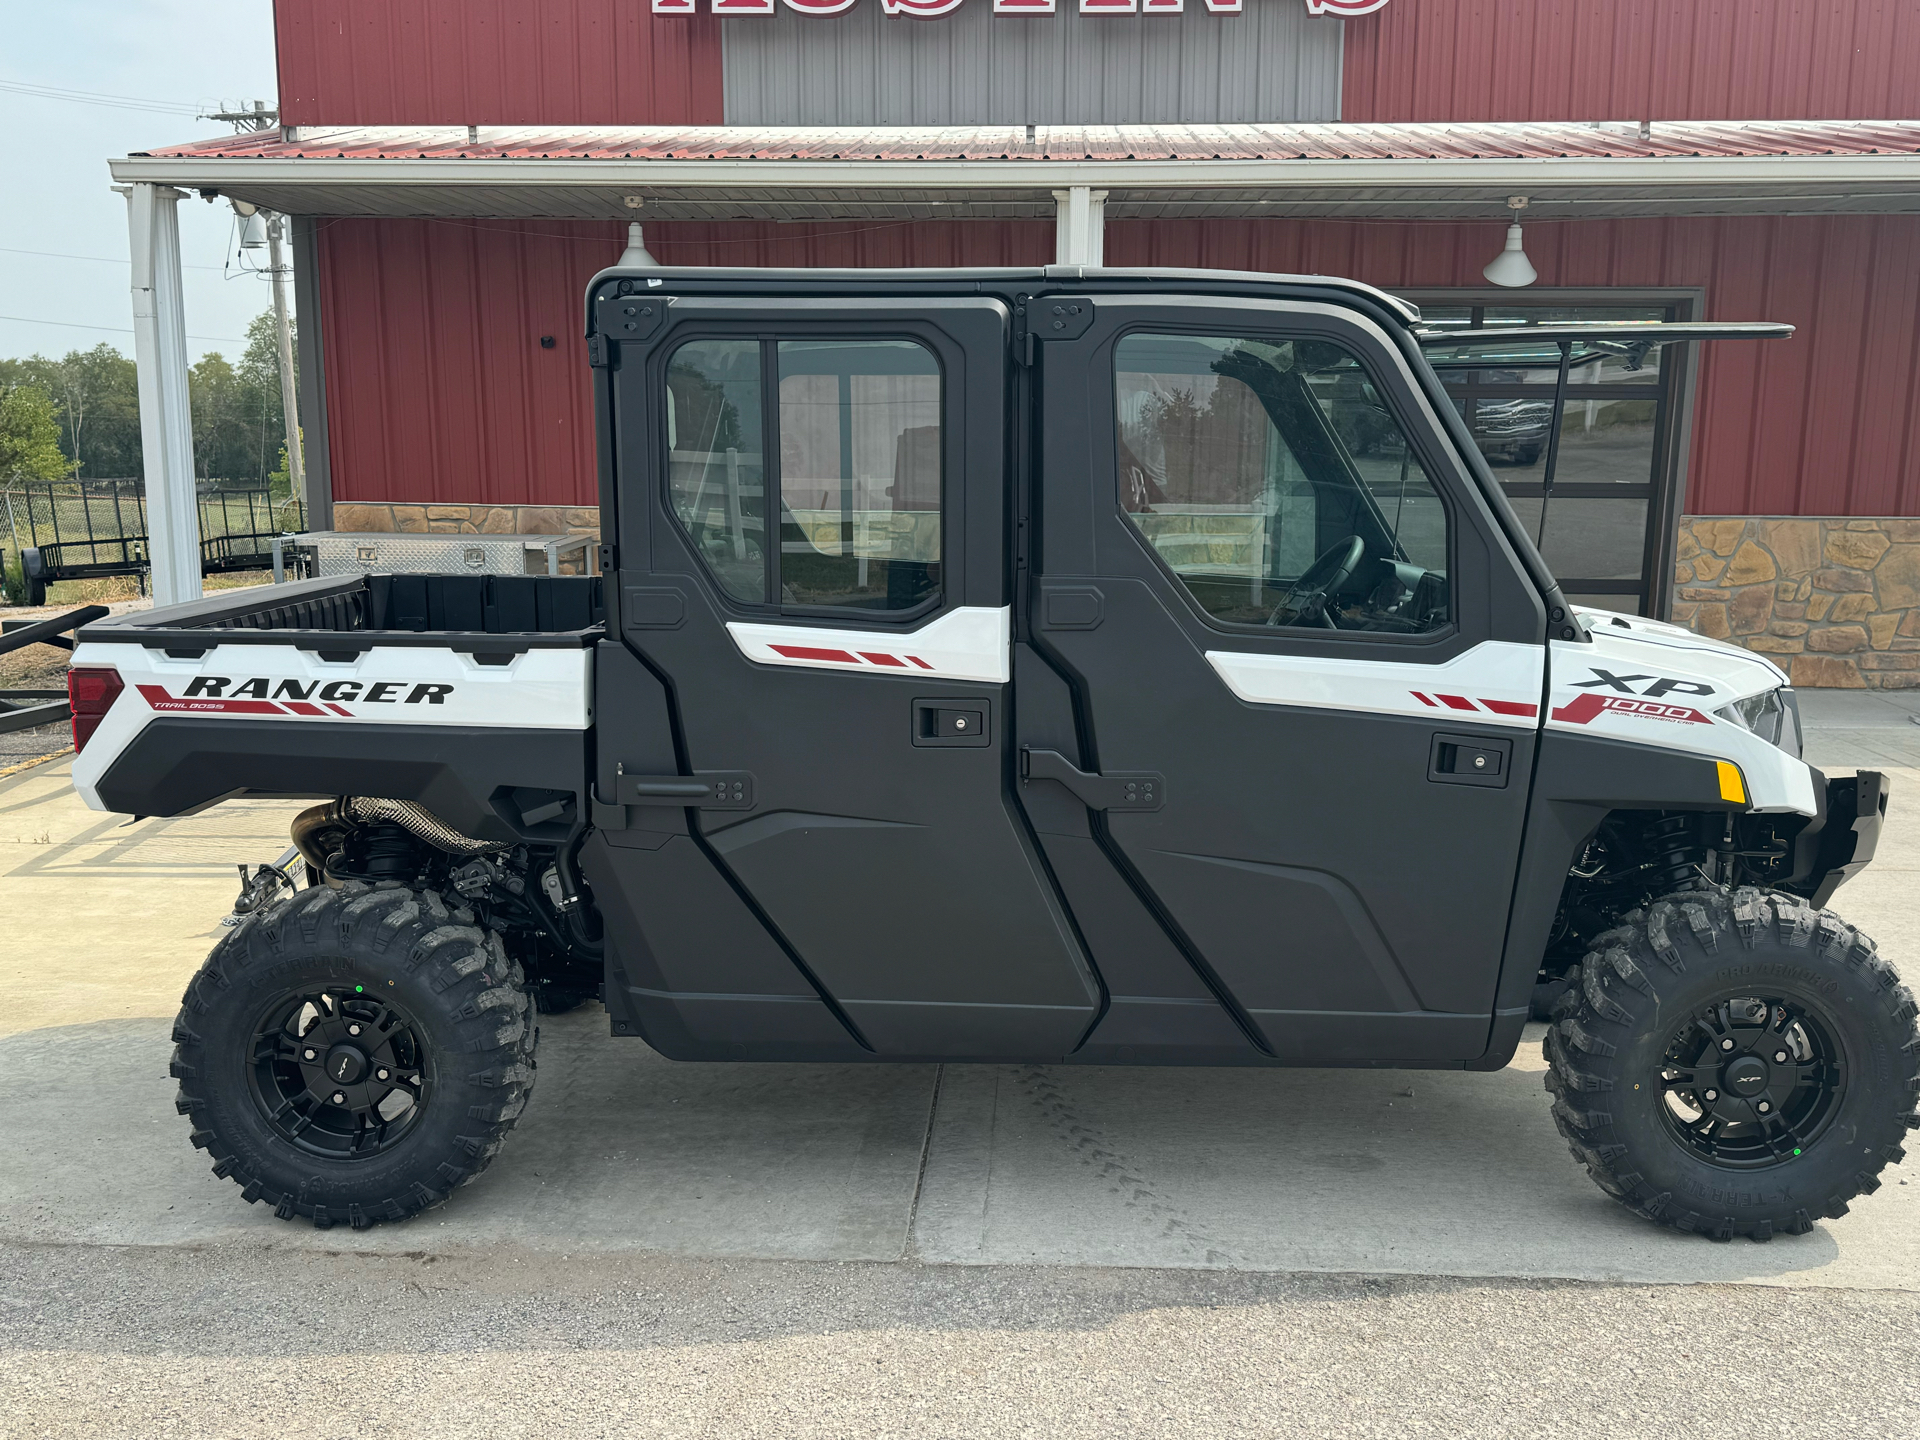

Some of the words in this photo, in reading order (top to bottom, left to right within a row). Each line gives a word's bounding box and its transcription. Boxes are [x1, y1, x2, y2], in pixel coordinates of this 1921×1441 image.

[182, 675, 455, 705] RANGER
[1566, 667, 1716, 698] XP
[1601, 697, 1693, 719] 1000
[1633, 713, 1677, 724] OVERHEAD
[1716, 963, 1755, 981] PRO
[1757, 962, 1823, 986] ARMOR
[337, 1057, 348, 1079] XP
[1675, 1173, 1796, 1208] X-TERRAIN
